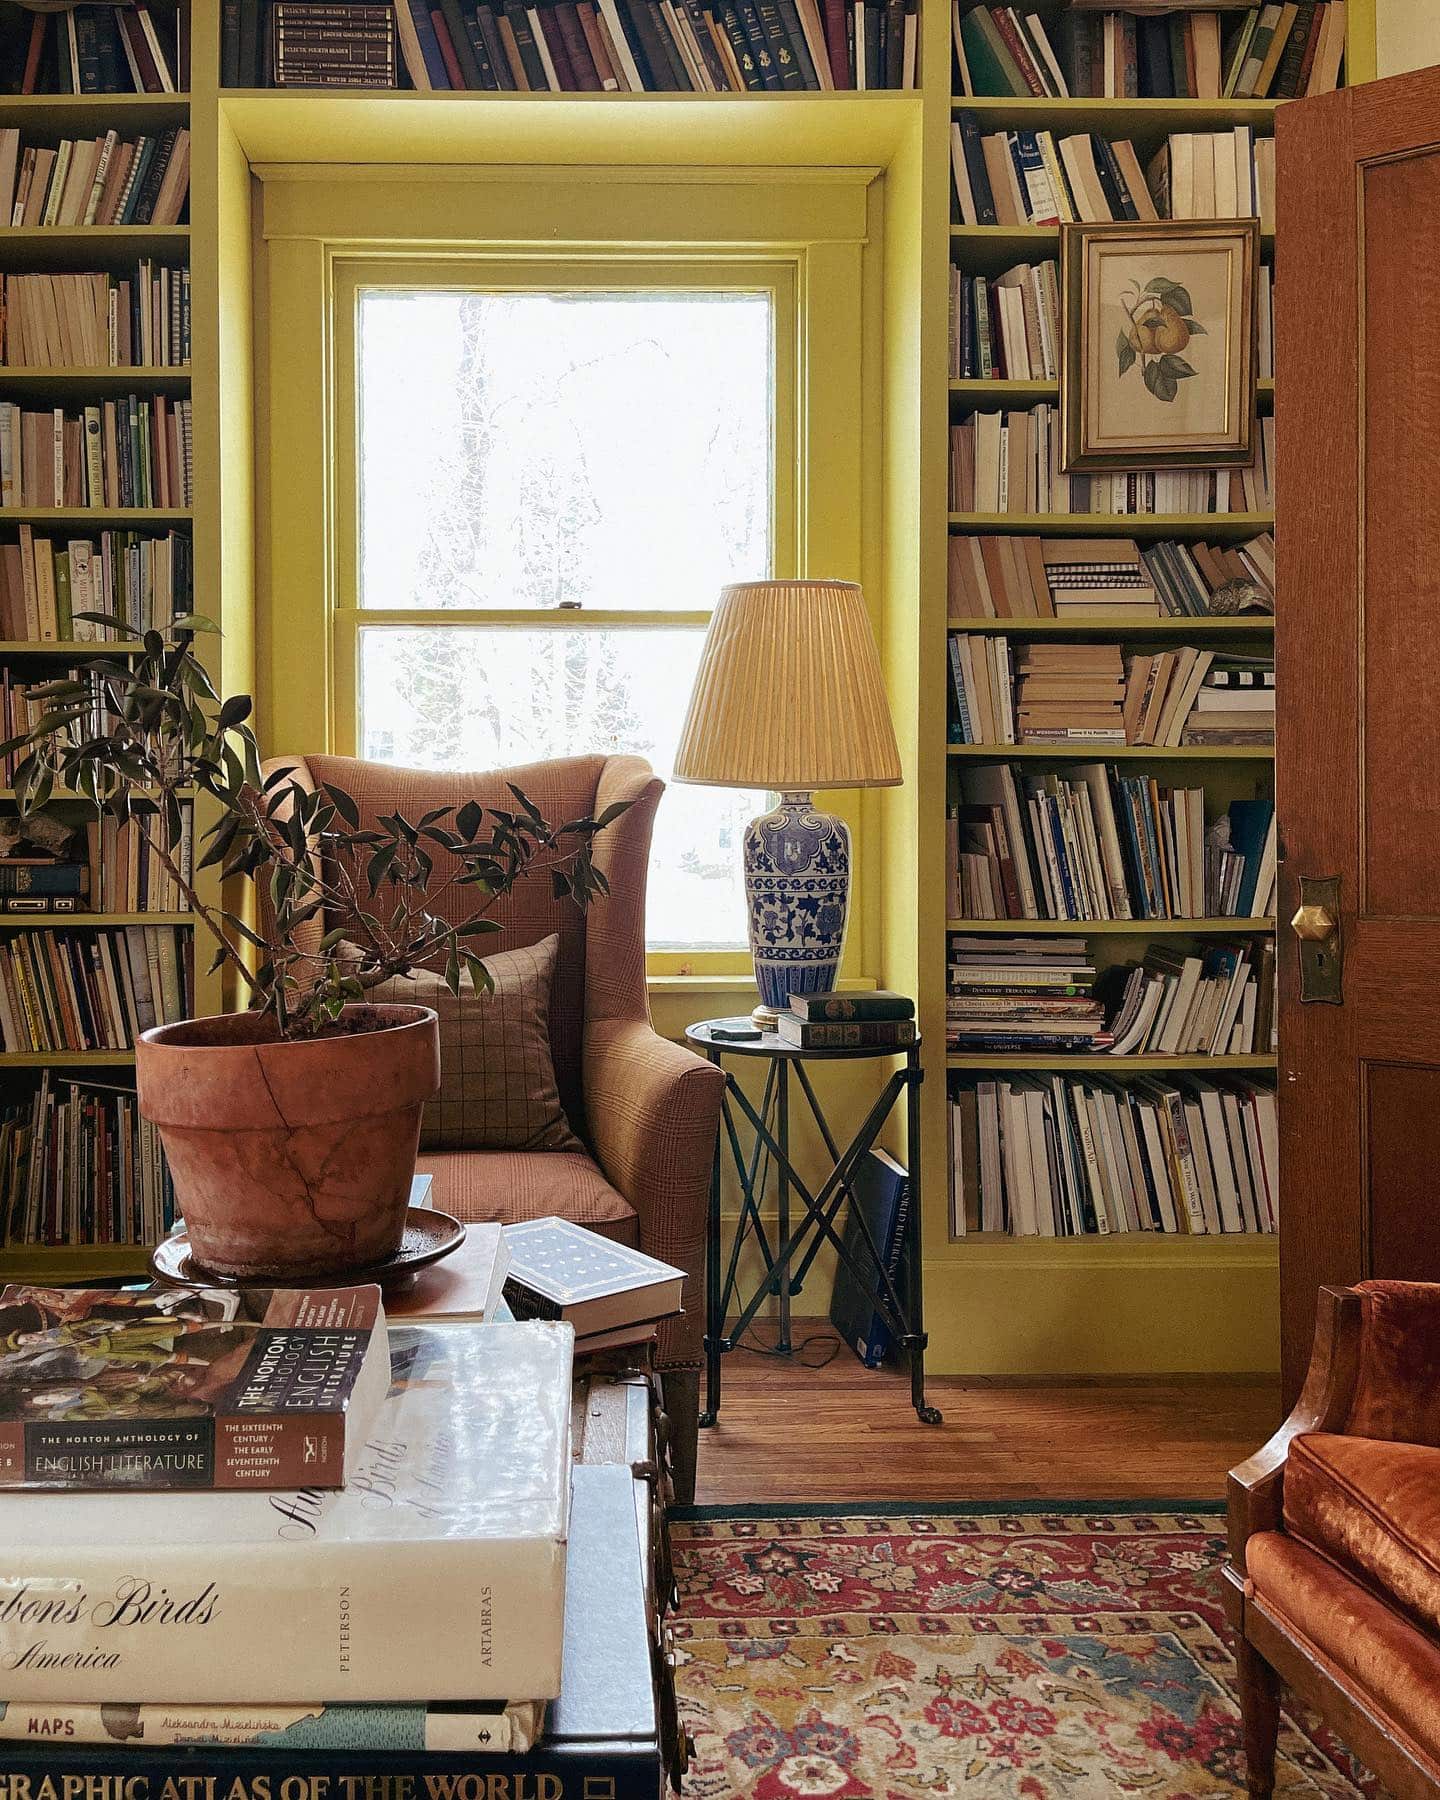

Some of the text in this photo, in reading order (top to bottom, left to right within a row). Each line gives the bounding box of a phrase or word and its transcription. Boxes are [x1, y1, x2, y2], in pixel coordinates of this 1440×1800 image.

[238, 1336, 289, 1408] THE NORTON
[285, 1336, 340, 1408] ENGLISH
[317, 1336, 357, 1407] LITERATURE
[41, 1433, 200, 1444] THE NORTON ANTHOLOGY OF
[225, 1423, 283, 1432] THE SIXTEENTH
[233, 1435, 268, 1443] CENTURY
[35, 1454, 205, 1472] ENGLISH LITERATURE
[226, 1457, 280, 1466] SEVENTEENTH
[234, 1446, 274, 1454] THE EARLY
[235, 1469, 271, 1478] CENTURY
[0, 1584, 88, 1624] bon's
[91, 1575, 222, 1627] Birds
[340, 1586, 350, 1673] PETERSON
[481, 1586, 492, 1667] ARTABRAS
[3, 1639, 124, 1671] America
[28, 1718, 75, 1735] MAPS
[160, 1775, 273, 1800] ATLAS
[280, 1774, 330, 1800] OF
[339, 1774, 417, 1800] THE
[422, 1773, 564, 1800] WORLD
